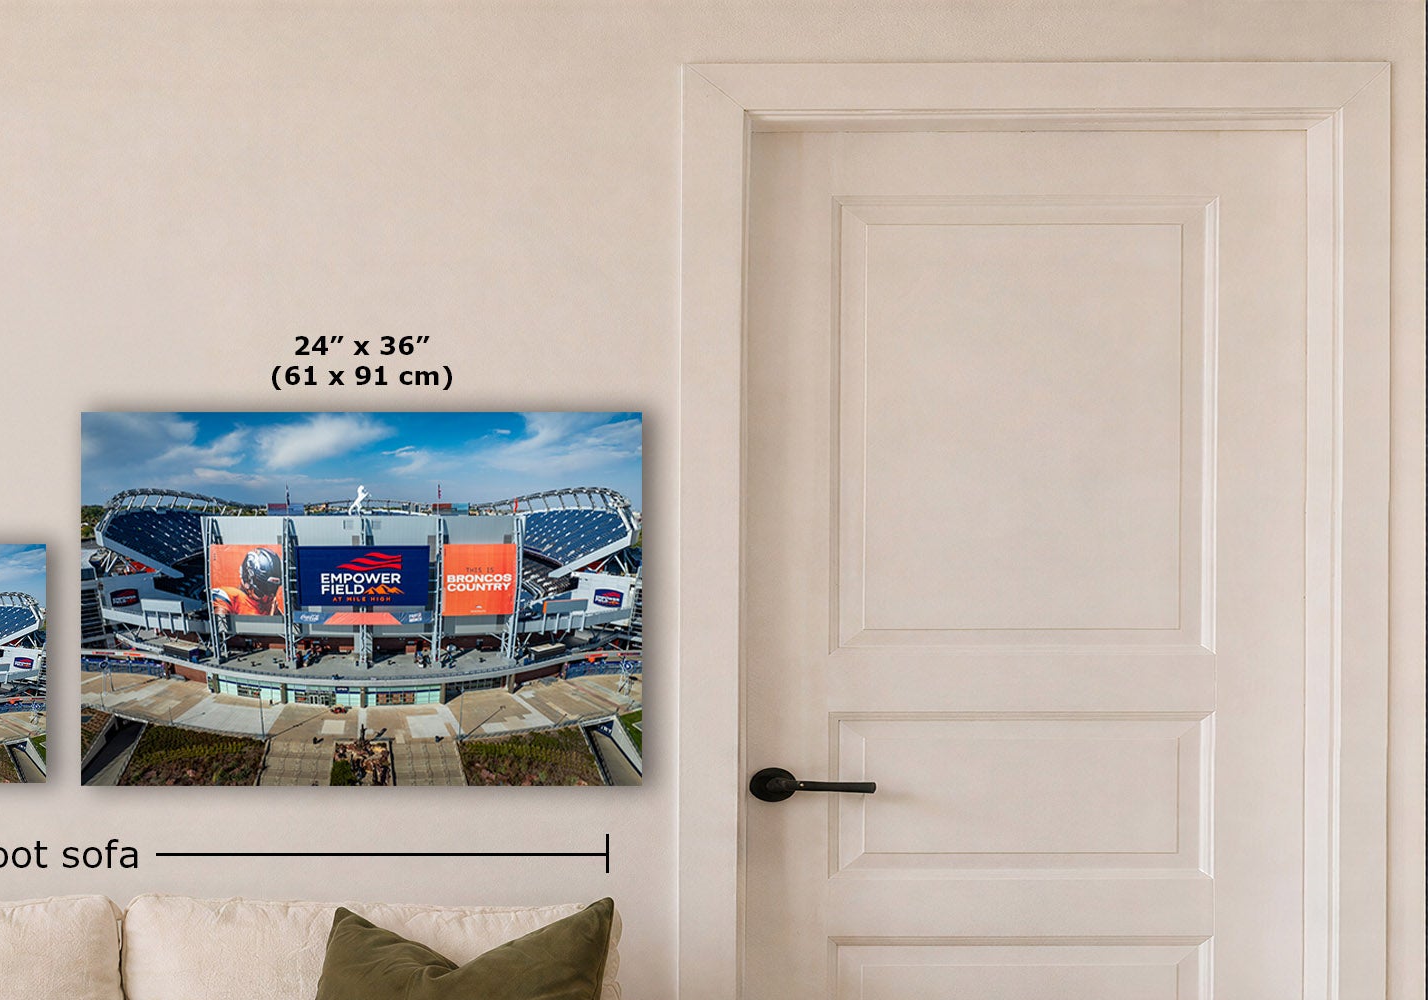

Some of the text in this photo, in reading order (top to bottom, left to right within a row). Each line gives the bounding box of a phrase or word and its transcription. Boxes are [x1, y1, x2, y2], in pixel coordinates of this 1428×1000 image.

[320, 572, 402, 584] EMPOWER
[446, 573, 512, 583] BRONCOS
[320, 584, 365, 595] FIELD
[446, 582, 511, 592] COUNTRY
